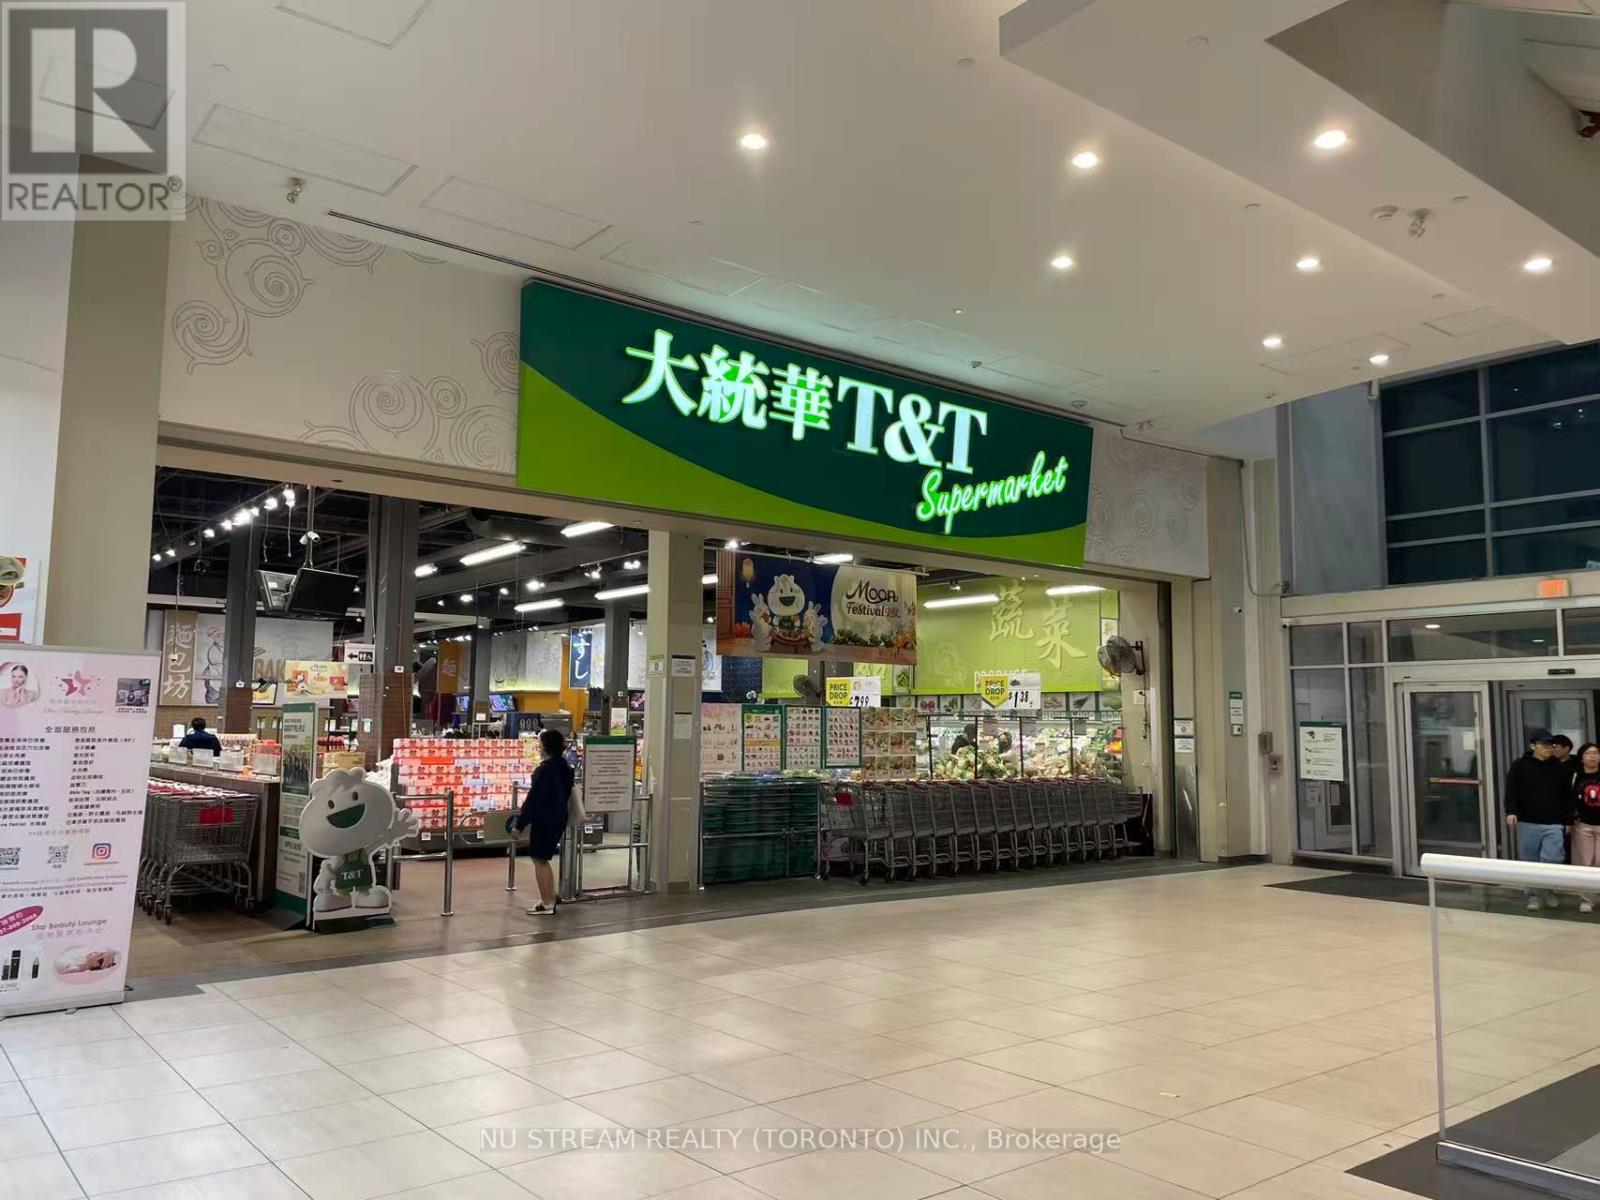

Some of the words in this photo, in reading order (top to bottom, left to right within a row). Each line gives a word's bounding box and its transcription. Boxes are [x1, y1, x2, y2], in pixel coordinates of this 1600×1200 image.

[621, 328, 832, 441] 大統華
[837, 376, 988, 475] T&T
[915, 450, 1070, 535] Supermarket
[845, 579, 899, 605] Moon
[846, 602, 885, 617] Festival
[990, 578, 1089, 672] 蔬菜
[572, 637, 591, 680] すし
[829, 683, 848, 692] PRICE
[829, 691, 848, 701] DROP
[984, 688, 1005, 696] DROP
[48, 922, 76, 930] Beauty
[78, 919, 107, 927] Lounge
